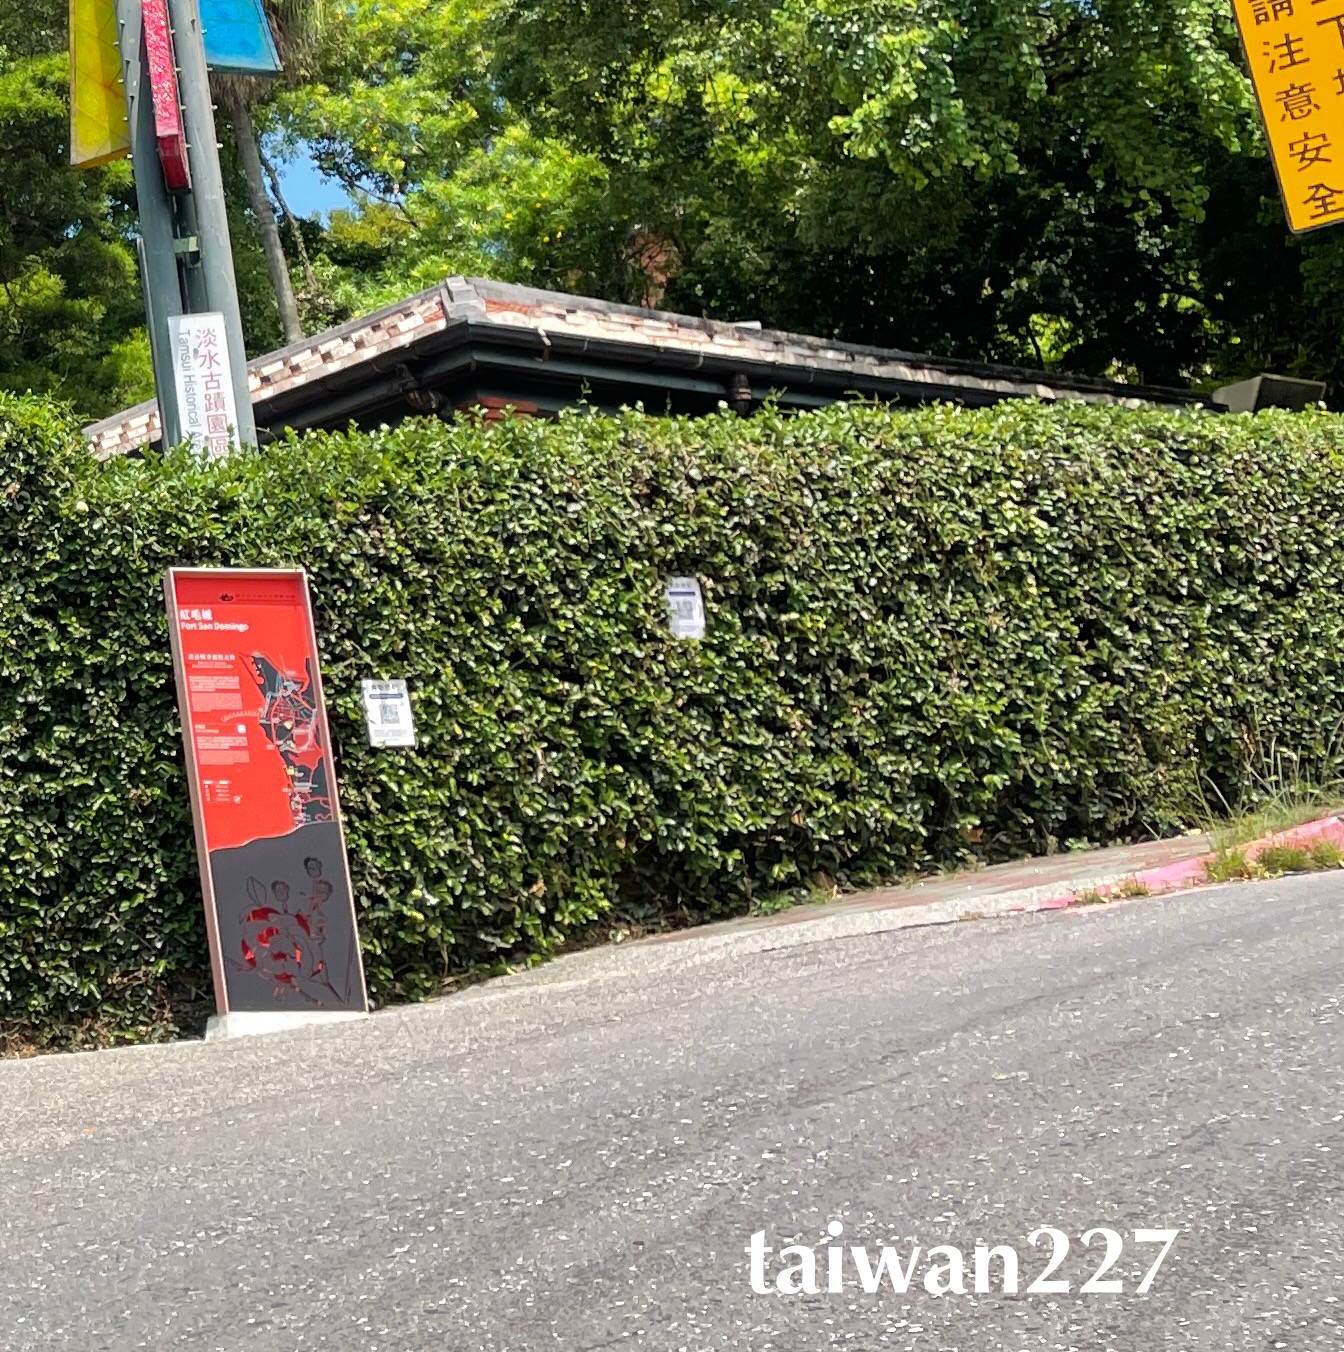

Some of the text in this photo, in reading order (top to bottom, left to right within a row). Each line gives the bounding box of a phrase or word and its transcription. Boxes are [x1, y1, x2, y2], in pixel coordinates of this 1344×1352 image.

[178, 329, 192, 372] Tamsui
[184, 375, 202, 428] Historical
[196, 327, 229, 456] 淡水古蹟園區
[180, 609, 212, 621] 紅毛城
[180, 622, 249, 632] Fort San Domingo
